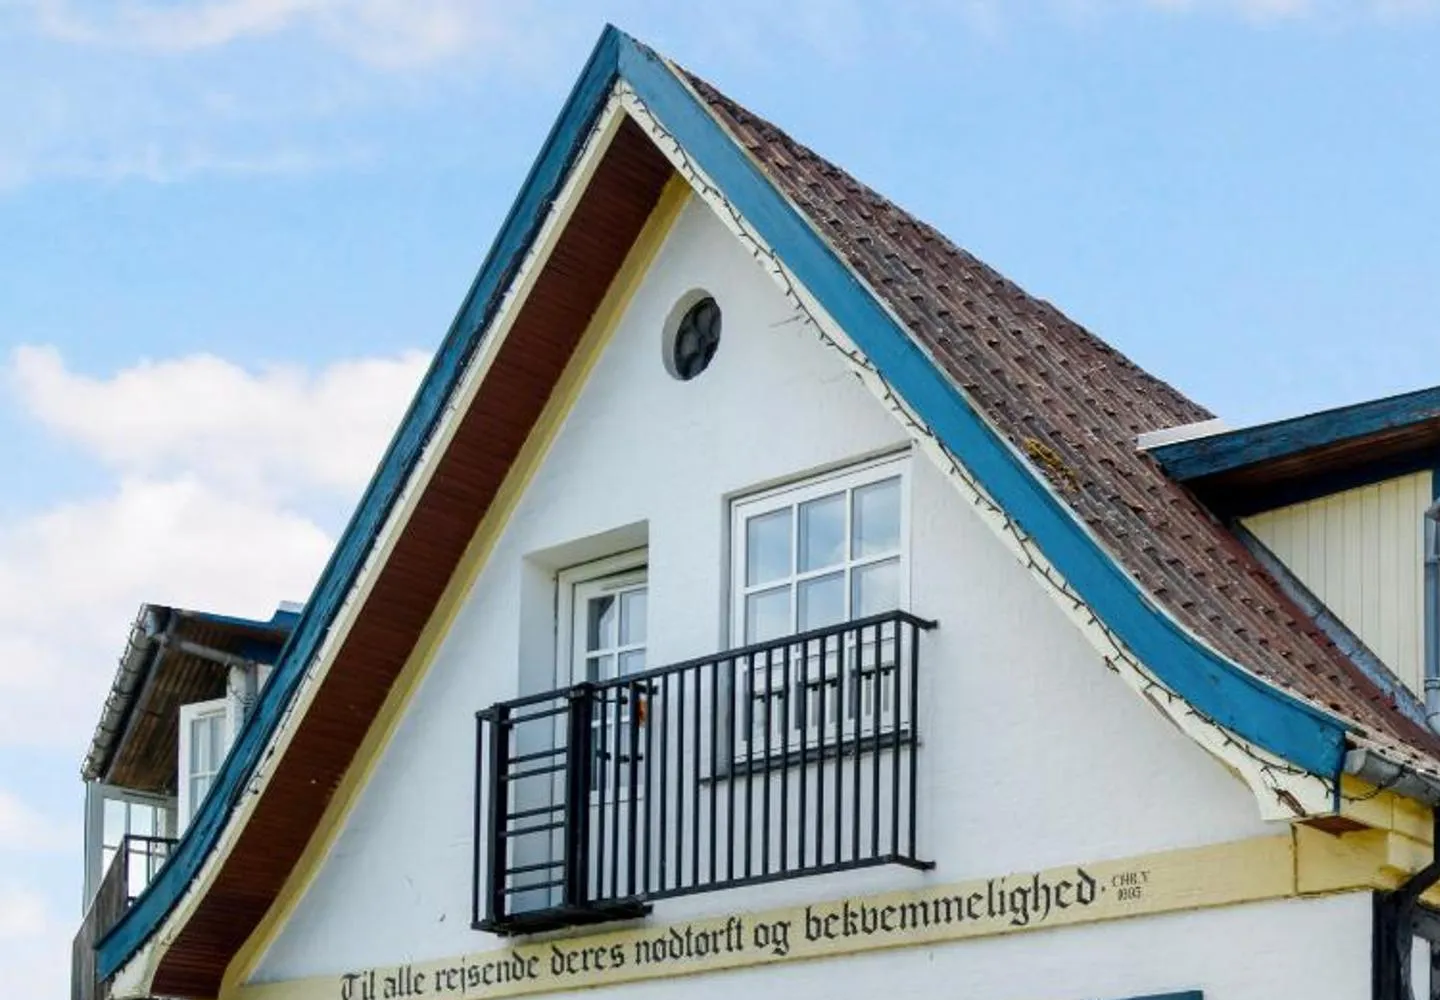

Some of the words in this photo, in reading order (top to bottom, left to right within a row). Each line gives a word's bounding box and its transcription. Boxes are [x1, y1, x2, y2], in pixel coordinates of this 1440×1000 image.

[383, 963, 426, 998] alle
[551, 941, 626, 976] deres
[753, 919, 792, 956] og
